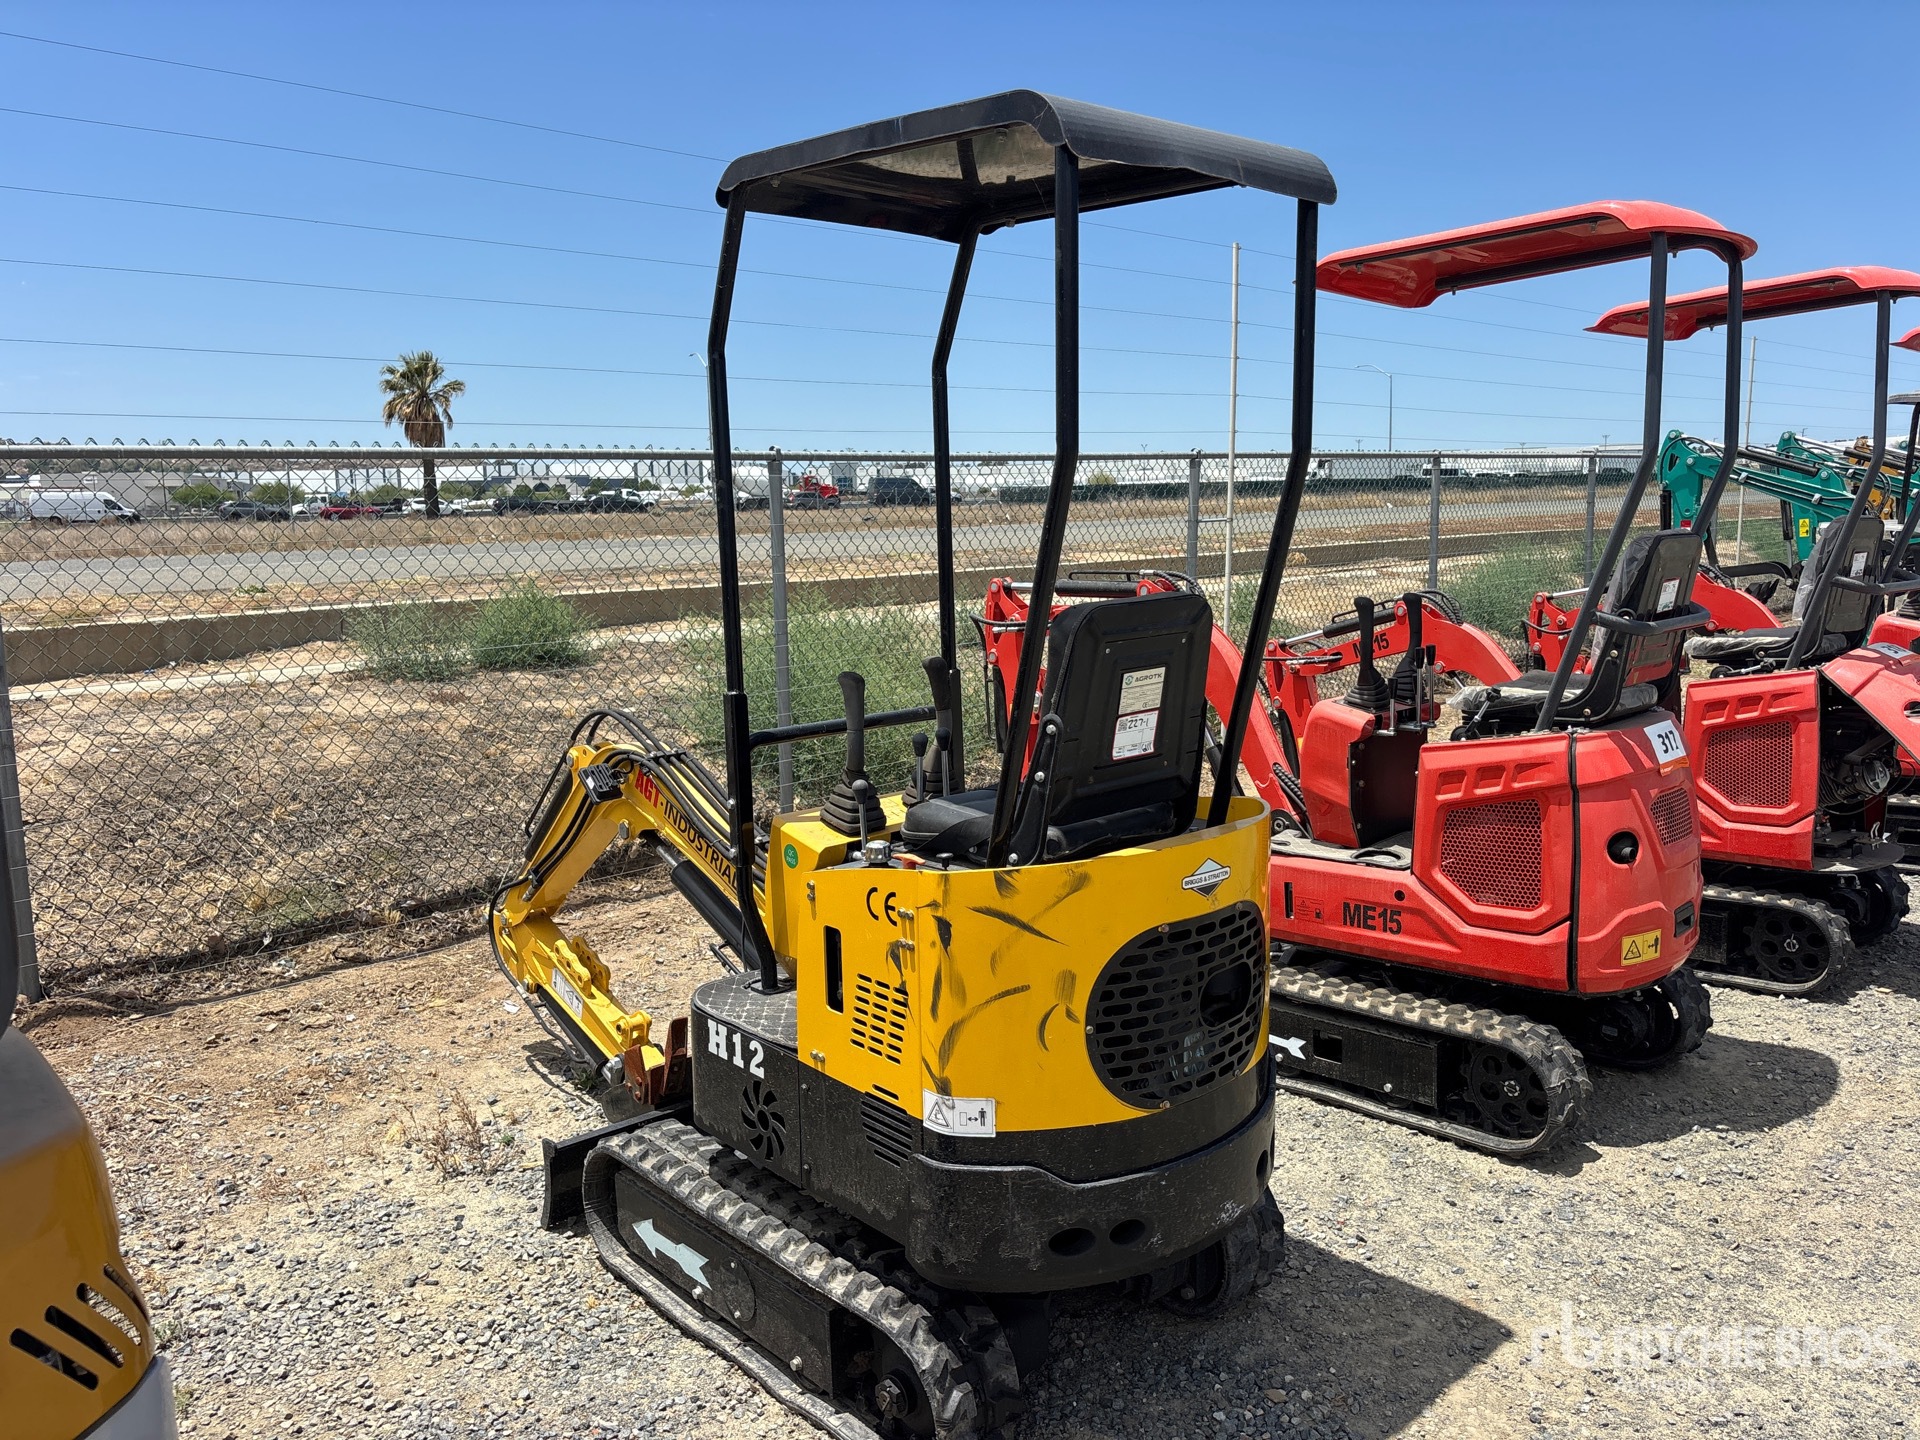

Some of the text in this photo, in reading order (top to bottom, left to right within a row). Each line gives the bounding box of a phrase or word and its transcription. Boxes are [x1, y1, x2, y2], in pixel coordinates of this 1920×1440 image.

[1352, 632, 1389, 659] M15
[1134, 672, 1163, 683] AGROTK
[1656, 729, 1679, 754] 317
[634, 768, 661, 809] AGT
[1184, 876, 1203, 887] BRIGGS
[1207, 870, 1229, 881] STRATTON
[865, 886, 898, 928] CE
[1342, 901, 1402, 935] ME15
[707, 1018, 765, 1079] H12
